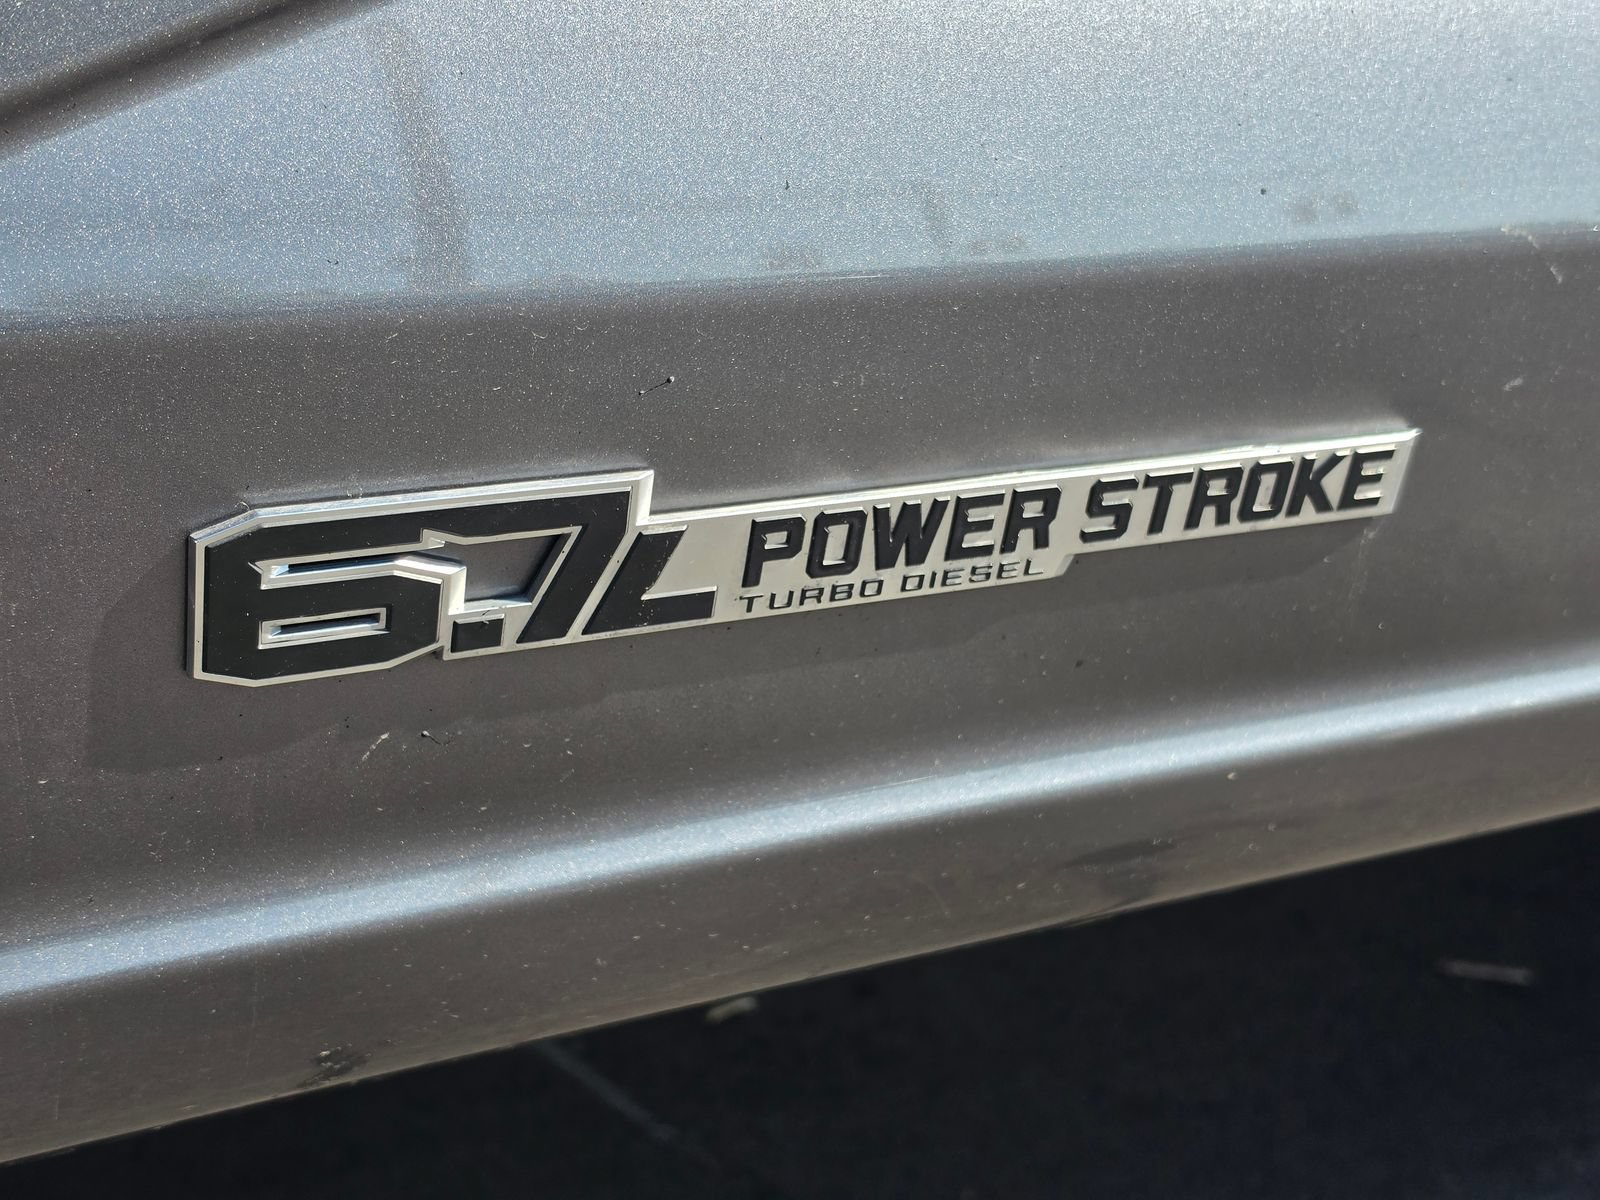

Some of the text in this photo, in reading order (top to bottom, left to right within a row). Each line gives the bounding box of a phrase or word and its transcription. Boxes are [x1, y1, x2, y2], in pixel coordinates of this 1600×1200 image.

[199, 444, 1397, 681] 6.7L POWER STROKE
[738, 558, 1044, 613] TURBO DIESEL
